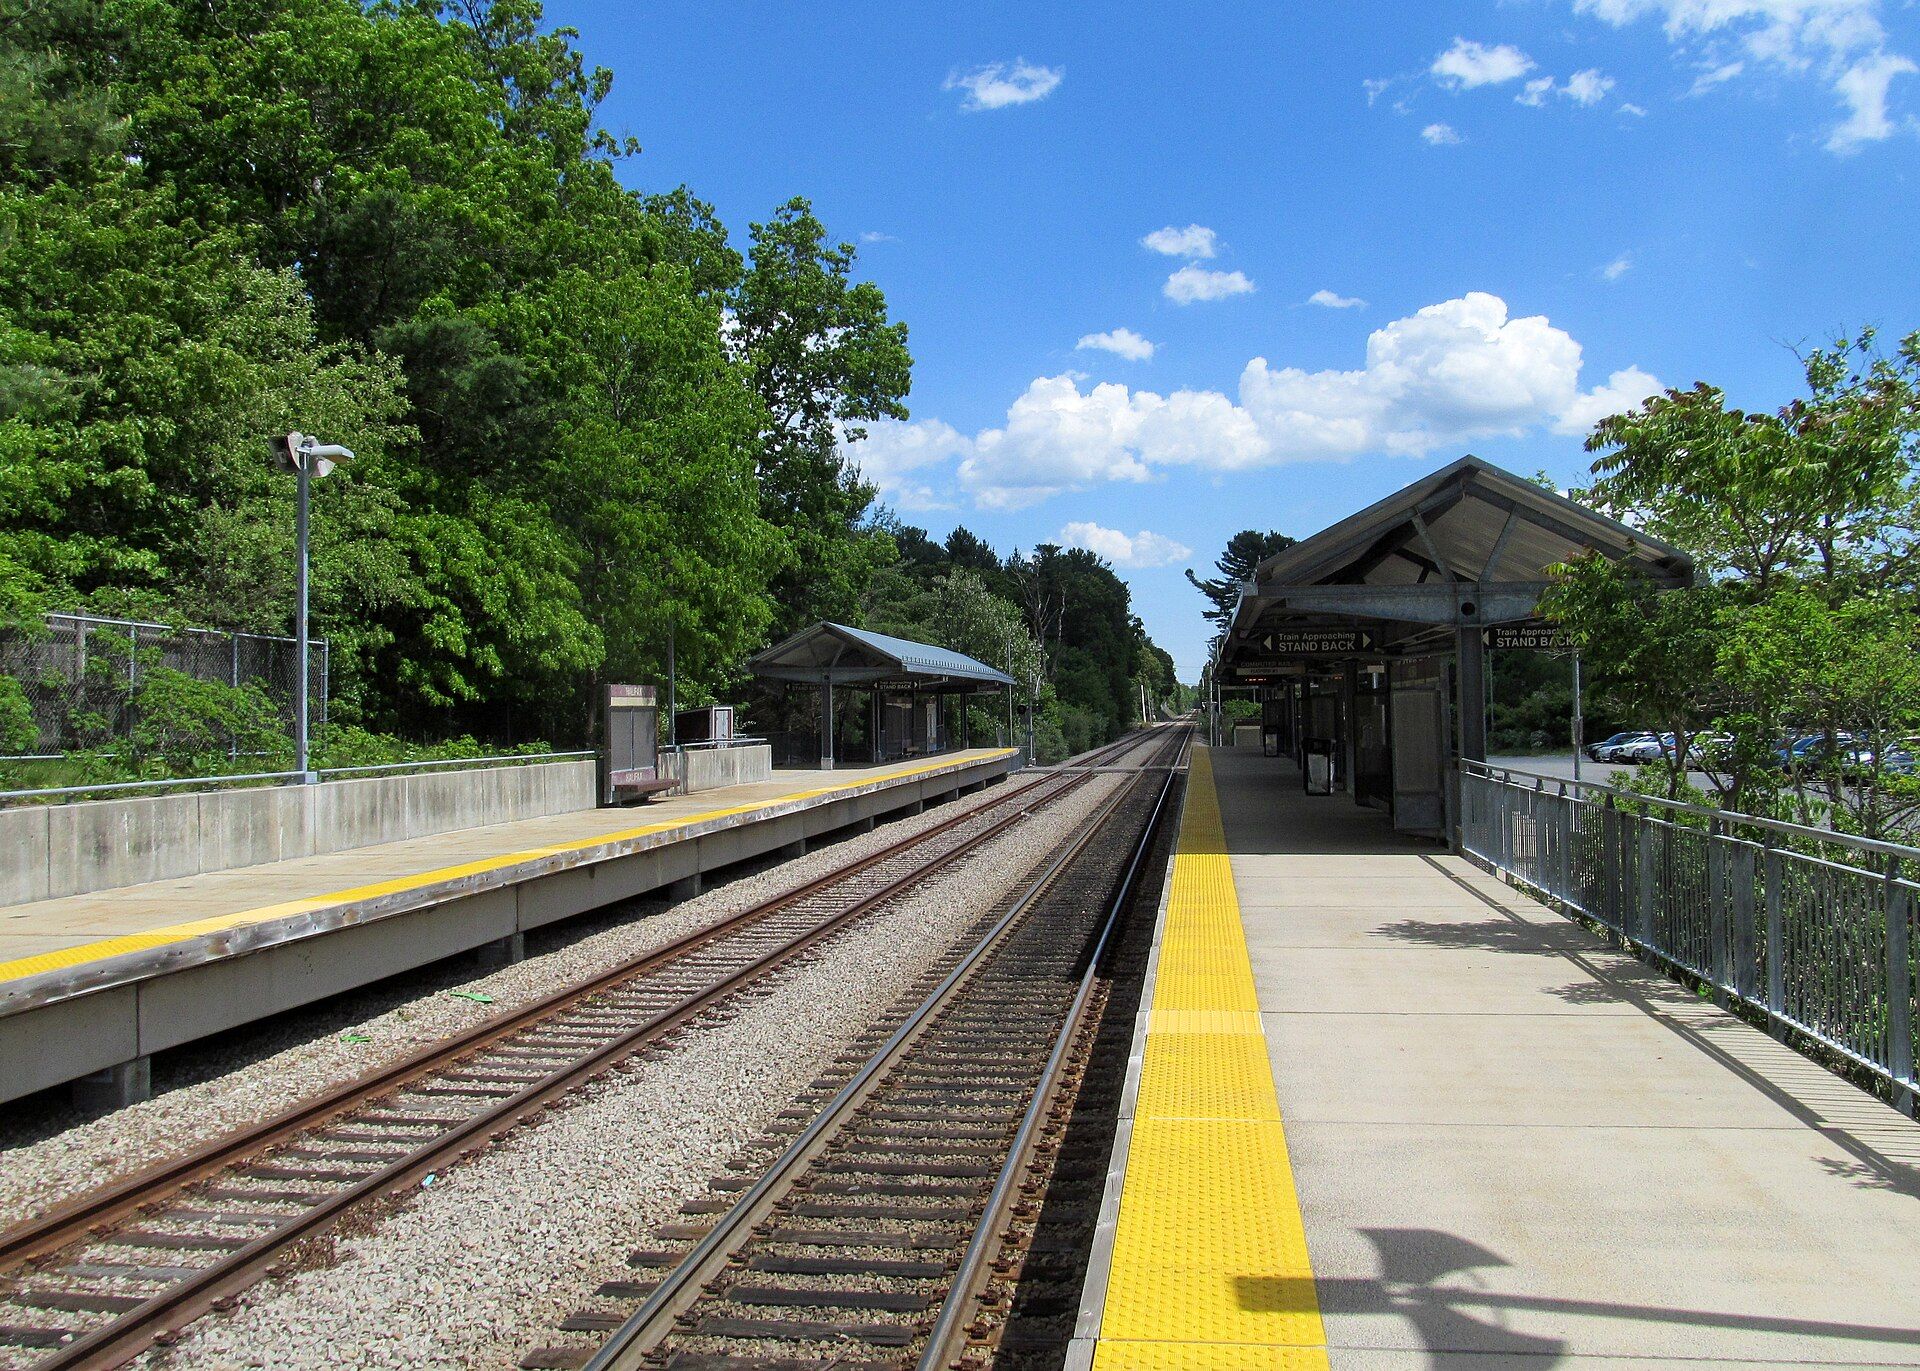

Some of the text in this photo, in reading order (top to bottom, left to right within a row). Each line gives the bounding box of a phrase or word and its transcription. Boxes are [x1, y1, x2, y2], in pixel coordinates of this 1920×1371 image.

[1302, 632, 1356, 640] Approaching
[1279, 641, 1355, 652] STAND BACK
[1496, 637, 1537, 647] STAND
